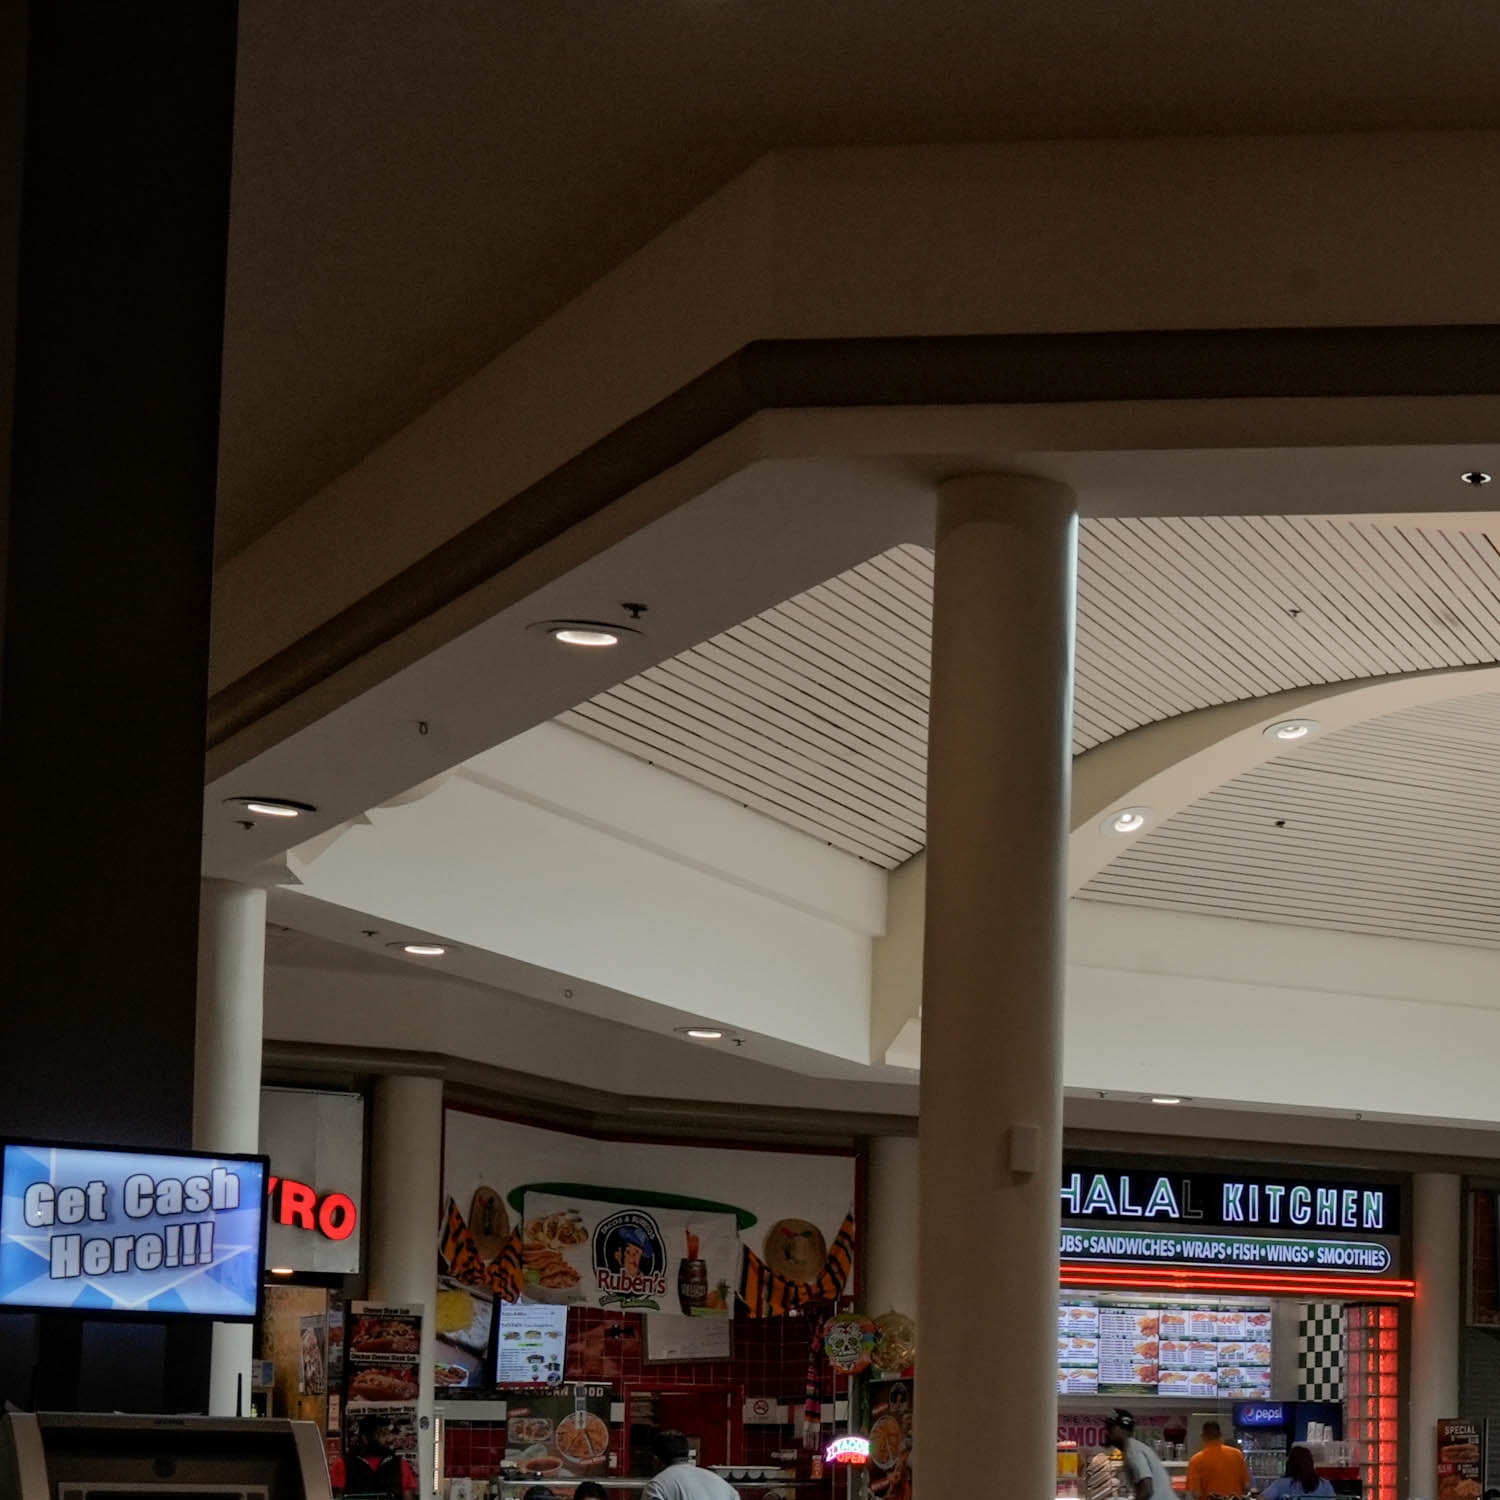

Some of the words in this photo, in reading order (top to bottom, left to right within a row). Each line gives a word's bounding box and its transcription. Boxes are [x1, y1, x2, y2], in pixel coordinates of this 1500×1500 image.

[24, 1180, 107, 1228] Get
[124, 1168, 241, 1219] Cash
[268, 1176, 357, 1241] RO
[1060, 1172, 1204, 1220] HALAL
[1222, 1182, 1384, 1230] KITCHEN
[49, 1221, 216, 1280] Here!!!
[1060, 1235, 1084, 1253] UBS
[1089, 1237, 1177, 1257] SANDWICHES
[1181, 1240, 1227, 1260] WRAPS
[1231, 1243, 1260, 1262] FISH
[1266, 1244, 1310, 1264] WINGS
[1316, 1246, 1386, 1268] SMOOTHIES
[1255, 1407, 1283, 1421] pepsi
[1444, 1425, 1476, 1435] SPECIAL
[837, 1453, 867, 1464] OPEN
